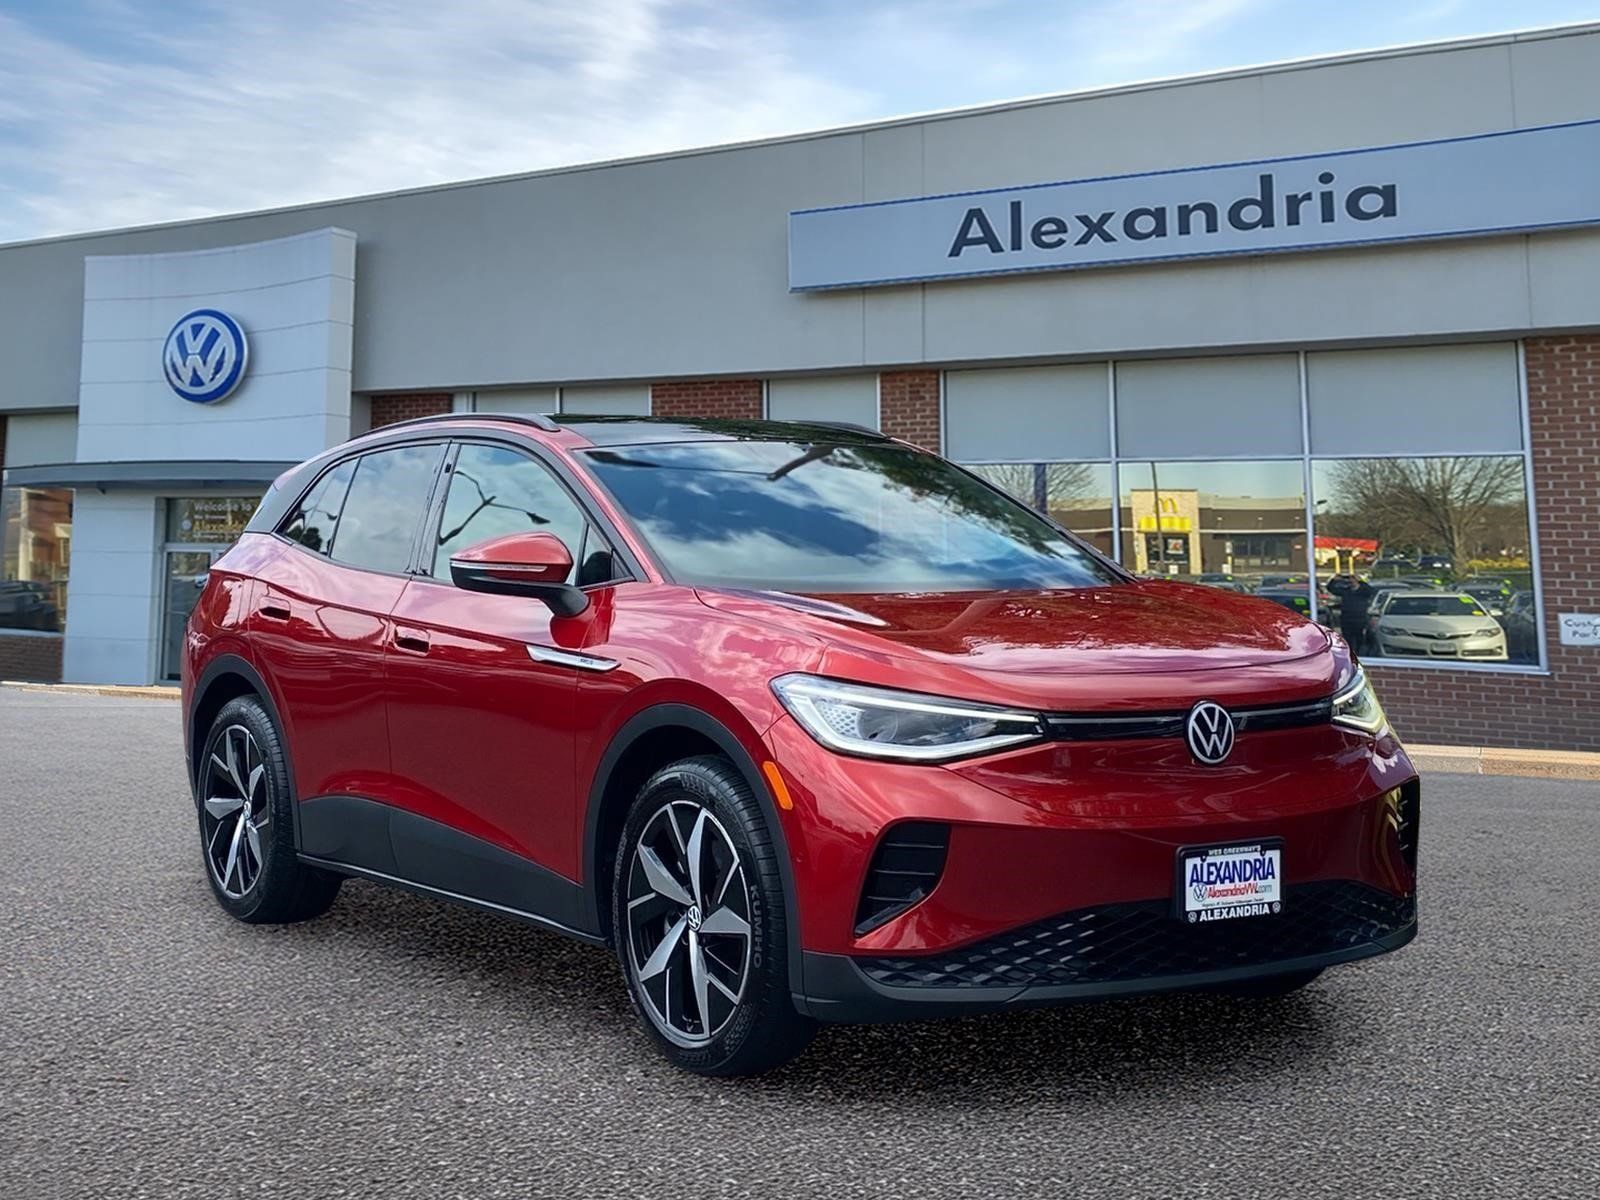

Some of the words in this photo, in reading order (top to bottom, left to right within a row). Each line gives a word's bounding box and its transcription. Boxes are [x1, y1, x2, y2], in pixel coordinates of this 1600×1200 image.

[947, 171, 1398, 258] Alexandria
[194, 502, 239, 512] Welcome
[1189, 856, 1276, 887] ALEXANDRIA
[750, 885, 762, 969] KUMHO
[1199, 903, 1271, 922] ALEXANDRIA
